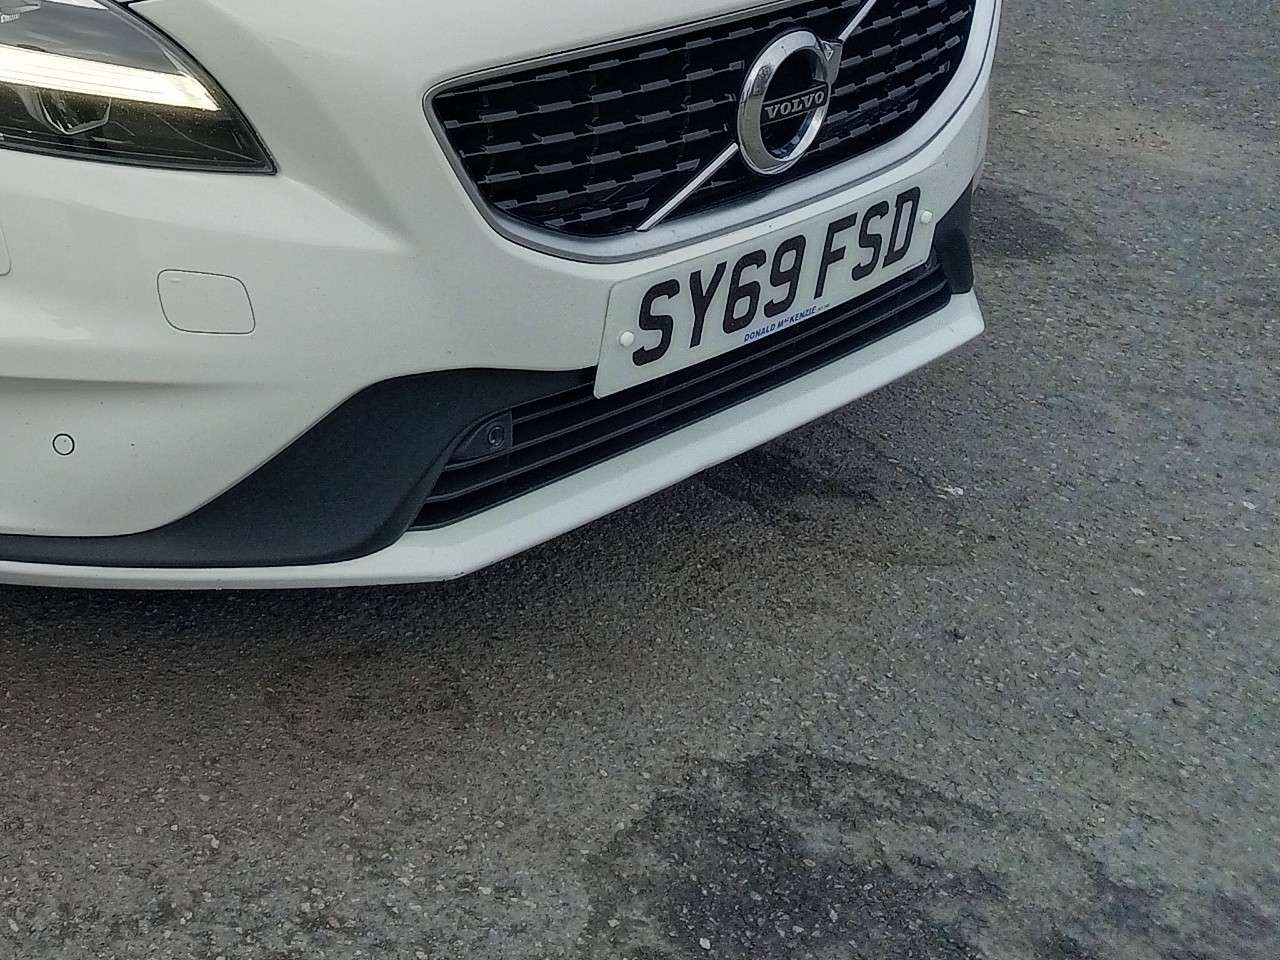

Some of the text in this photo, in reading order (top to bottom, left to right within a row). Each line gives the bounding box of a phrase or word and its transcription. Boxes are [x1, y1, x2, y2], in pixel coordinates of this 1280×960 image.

[764, 91, 825, 119] VOLVO
[632, 186, 921, 367] SY69 FSD
[744, 323, 776, 342] DONALD
